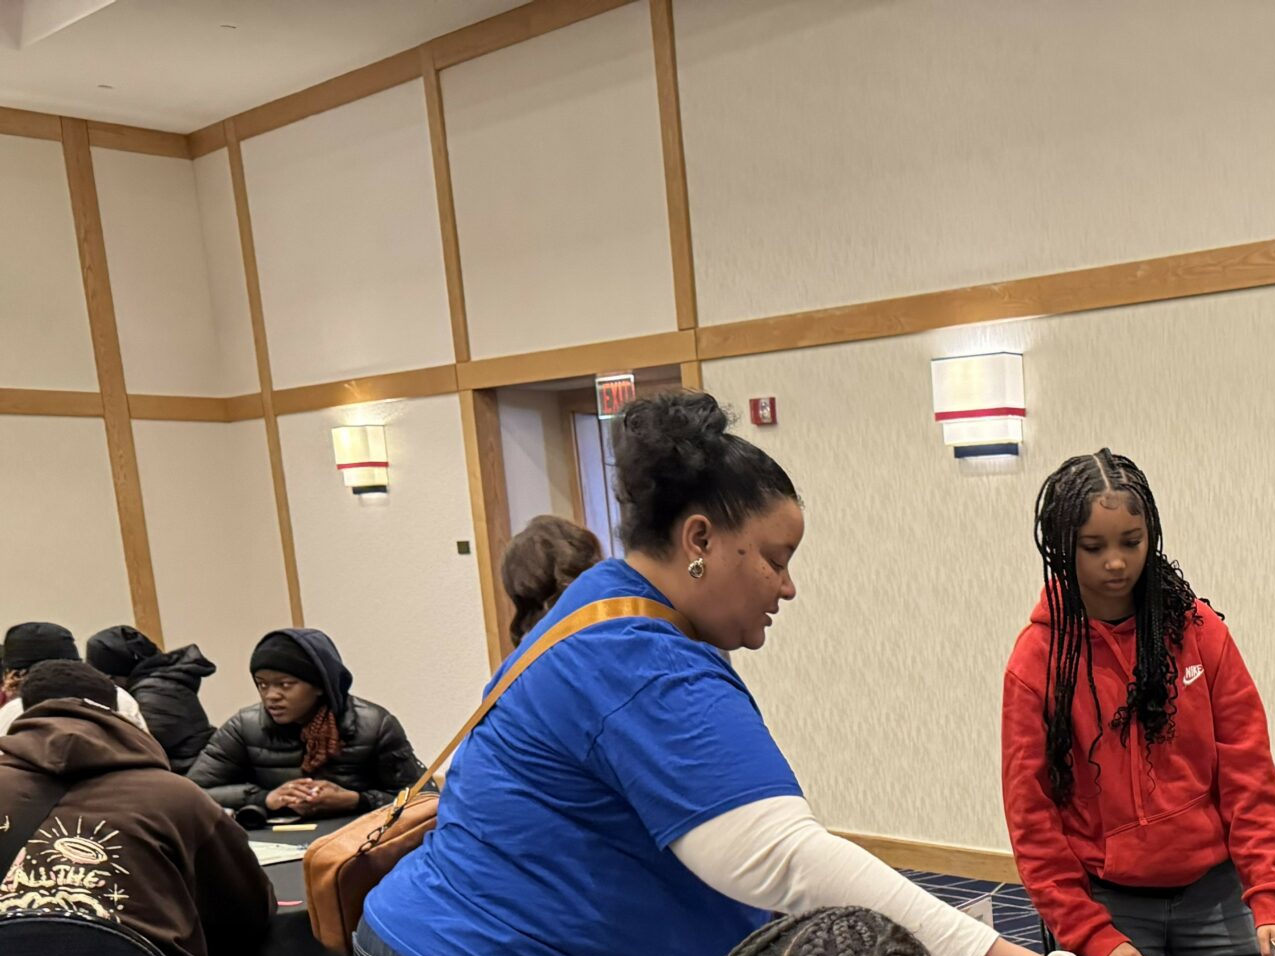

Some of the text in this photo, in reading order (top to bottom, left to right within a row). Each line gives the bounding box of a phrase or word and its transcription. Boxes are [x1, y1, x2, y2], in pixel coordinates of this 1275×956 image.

[602, 381, 632, 414] EXIT
[1185, 664, 1204, 679] NIKE
[52, 864, 107, 889] THE
